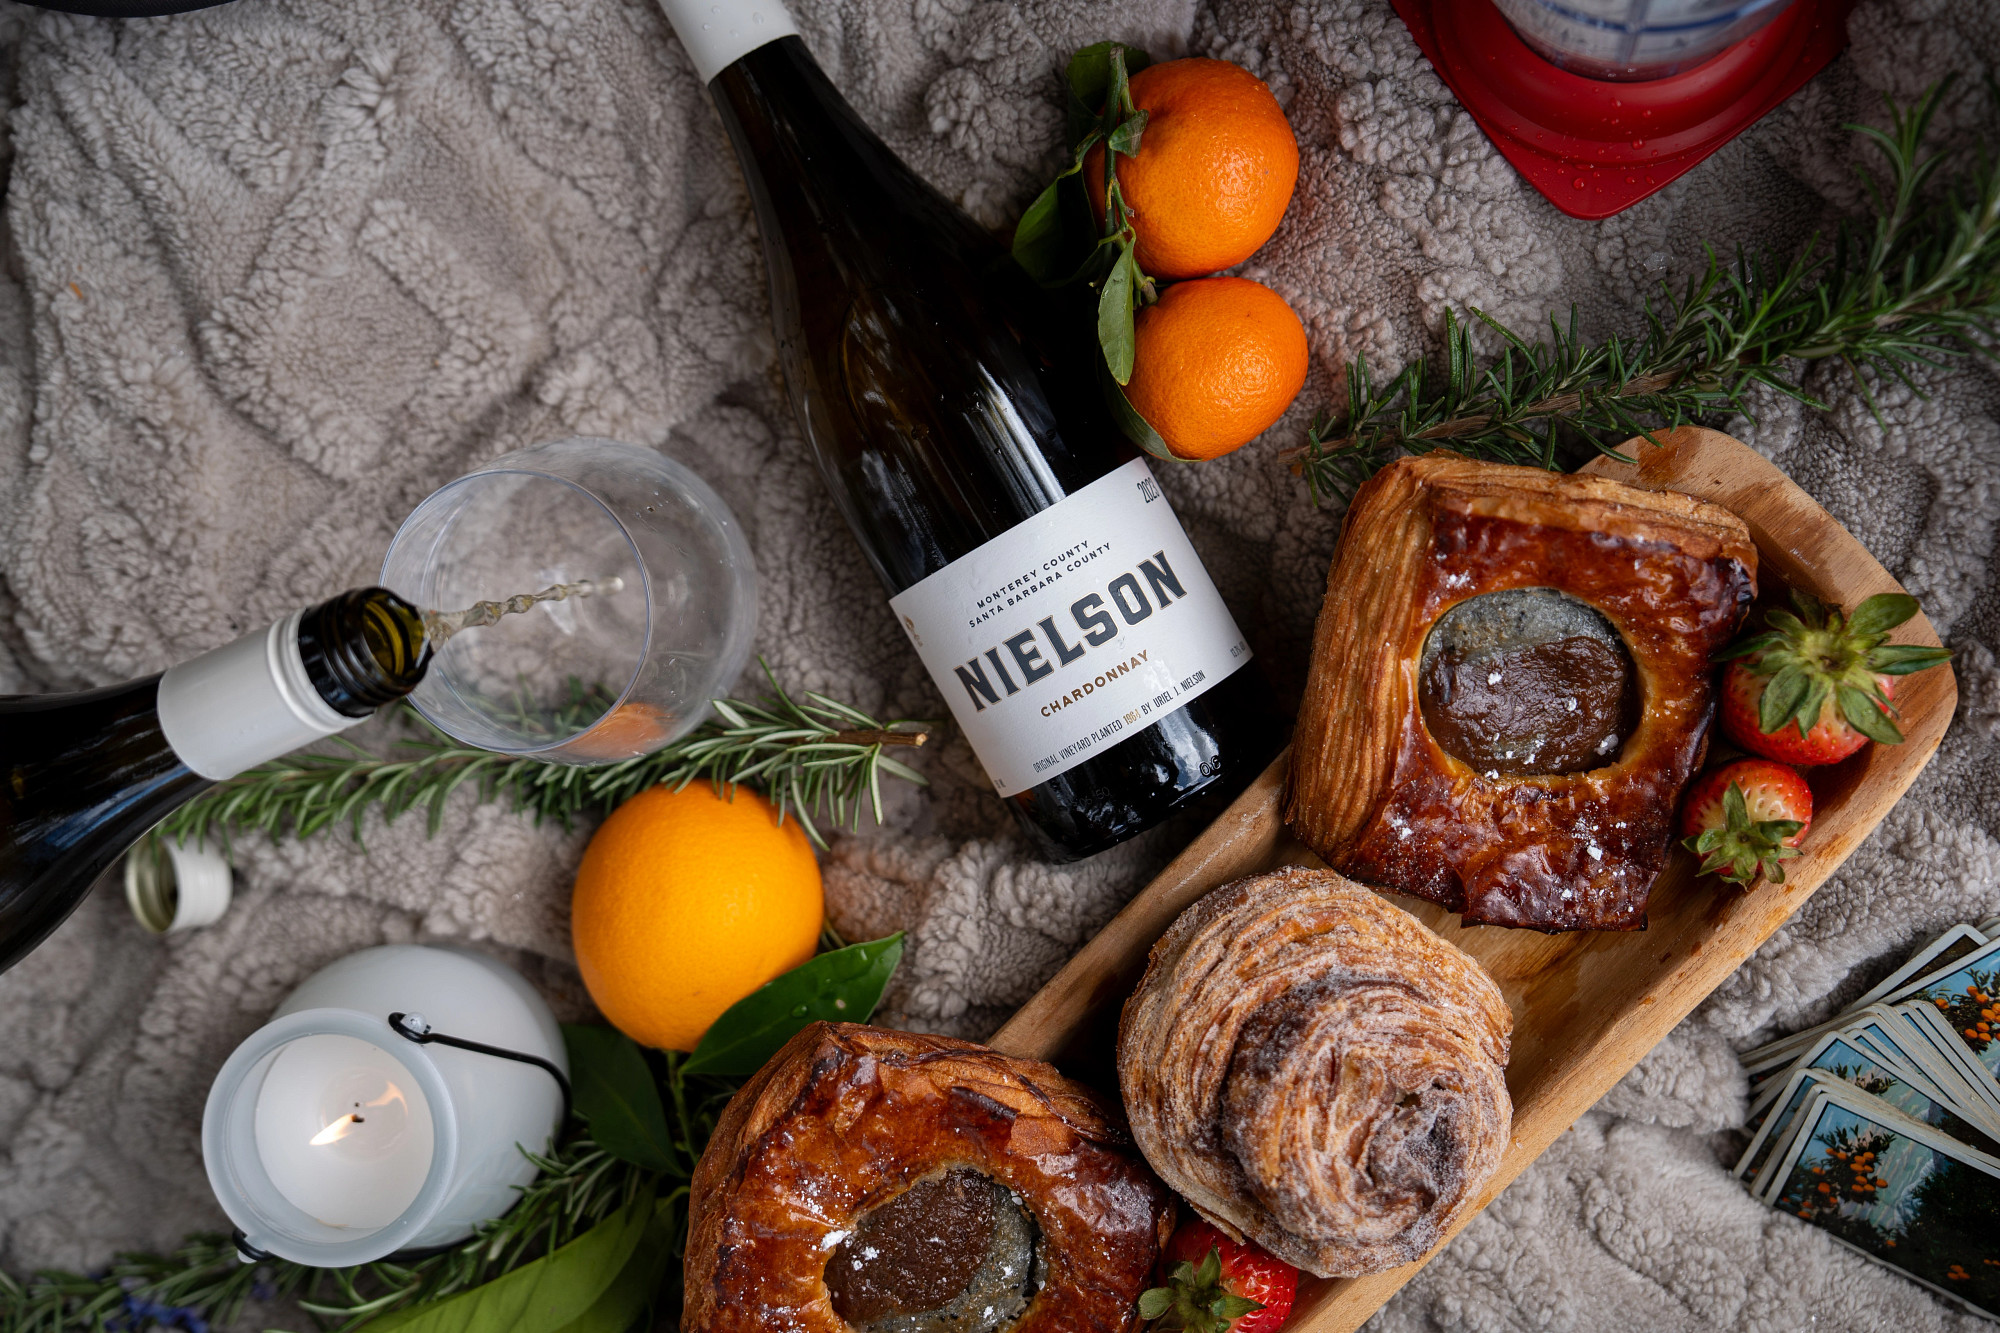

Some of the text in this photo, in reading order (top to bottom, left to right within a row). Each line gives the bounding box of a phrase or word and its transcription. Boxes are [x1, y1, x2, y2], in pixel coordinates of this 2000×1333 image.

[1136, 476, 1160, 504] 2023
[969, 542, 1111, 628] SANTA BARBARA COUNTY
[976, 540, 1089, 609] MONTEREY COUNTY
[953, 550, 1188, 713] NIELSON
[1032, 752, 1060, 773] ORIGINAL
[1058, 738, 1092, 760] VINEYARD
[1091, 719, 1123, 744] PLANTED
[1140, 702, 1153, 716] BY
[1152, 690, 1174, 708] URIEL
[1180, 669, 1206, 692] NIELSON
[1040, 649, 1149, 718] CHARDONNAY
